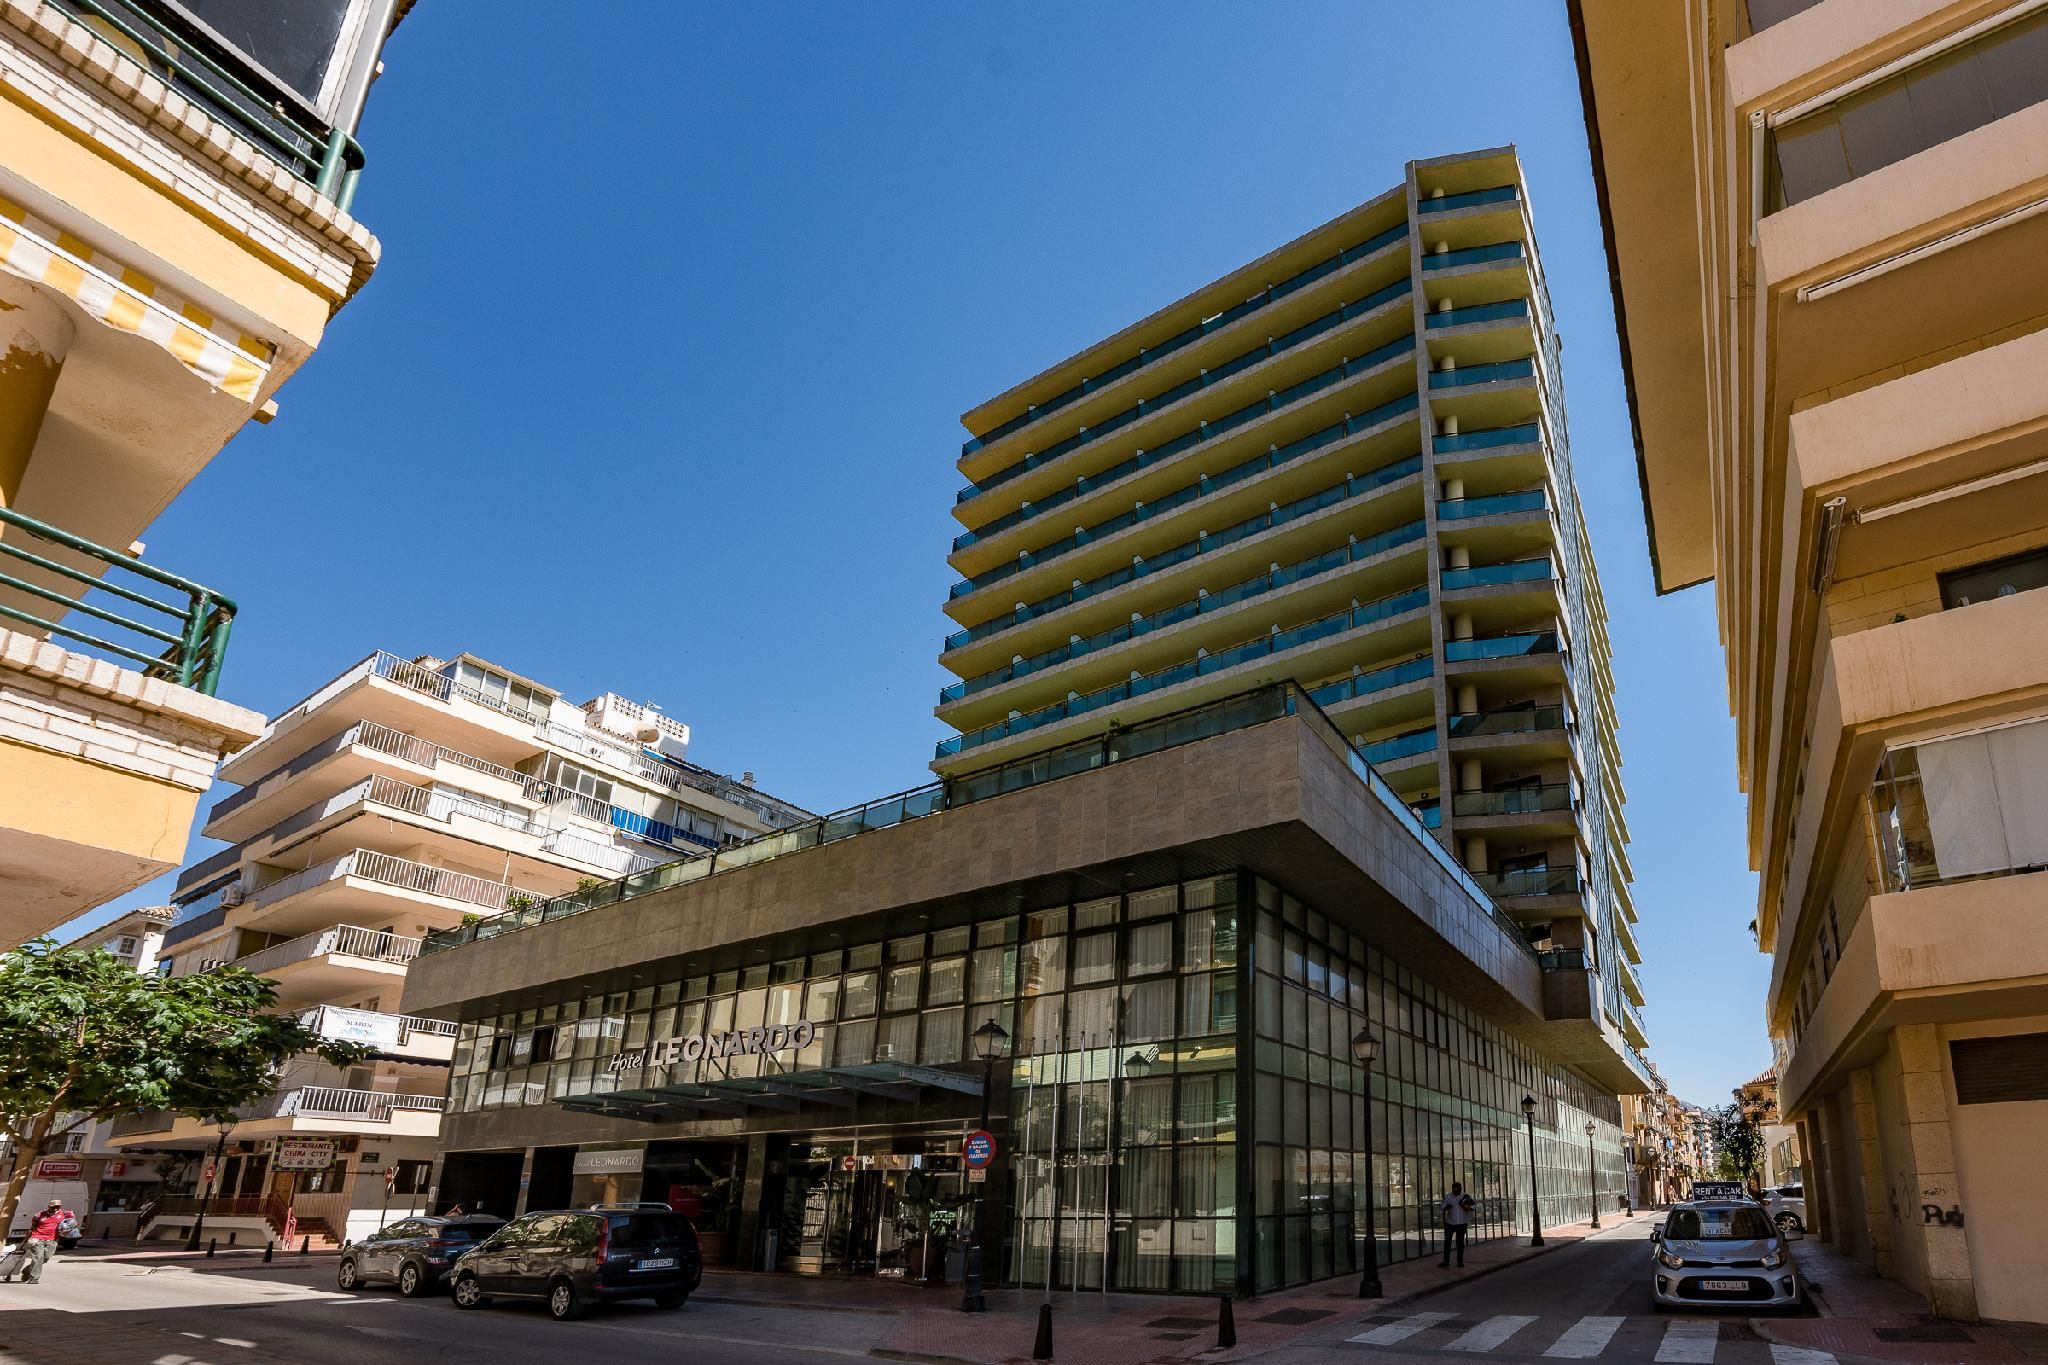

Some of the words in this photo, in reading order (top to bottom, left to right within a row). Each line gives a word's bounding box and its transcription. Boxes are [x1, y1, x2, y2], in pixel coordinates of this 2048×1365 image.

[608, 1049, 646, 1072] Hotel
[648, 1019, 815, 1067] LEONARDO
[284, 1141, 332, 1150] RESTAURANTE
[590, 1156, 639, 1167] LEONARDO
[1695, 1187, 1715, 1195] RENT
[1717, 1187, 1723, 1195] A
[1724, 1187, 1741, 1195] CAR
